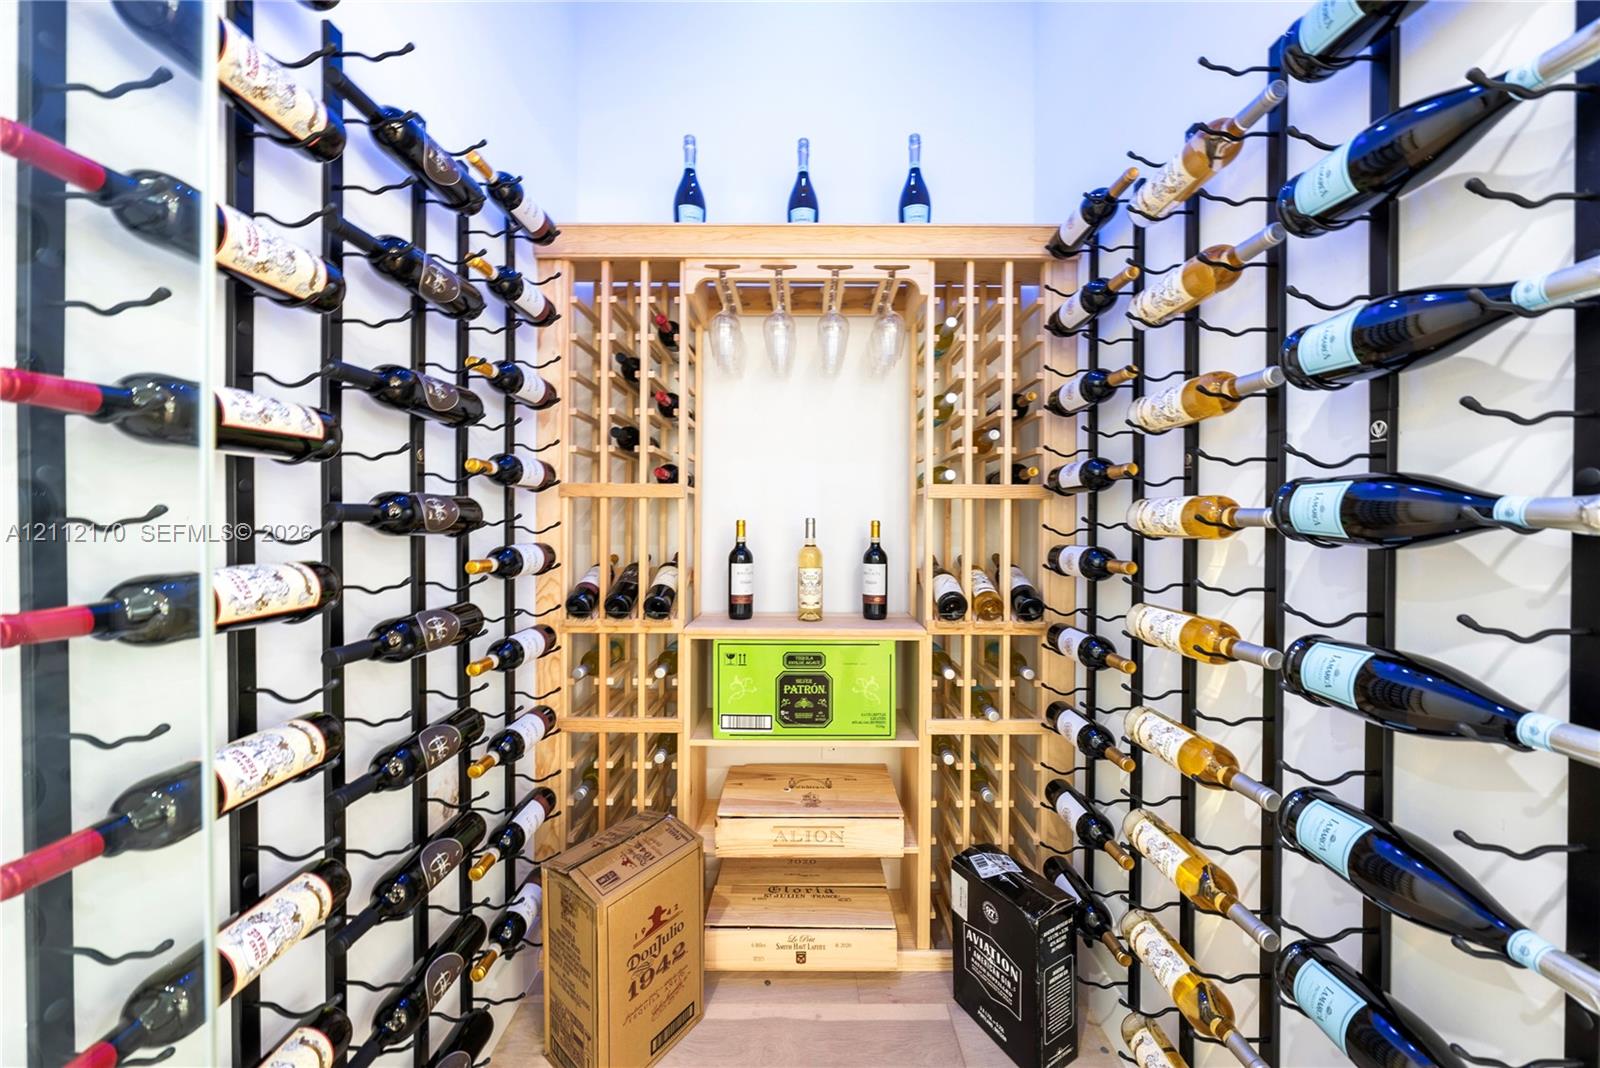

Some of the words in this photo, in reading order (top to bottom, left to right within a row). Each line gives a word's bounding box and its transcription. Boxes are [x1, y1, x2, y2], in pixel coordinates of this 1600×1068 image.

[783, 682, 826, 694] PATRÓN
[773, 830, 845, 843] ALION
[767, 885, 835, 894] Gloria
[966, 929, 1018, 983] AVIATION
[628, 941, 686, 1002] 1942
